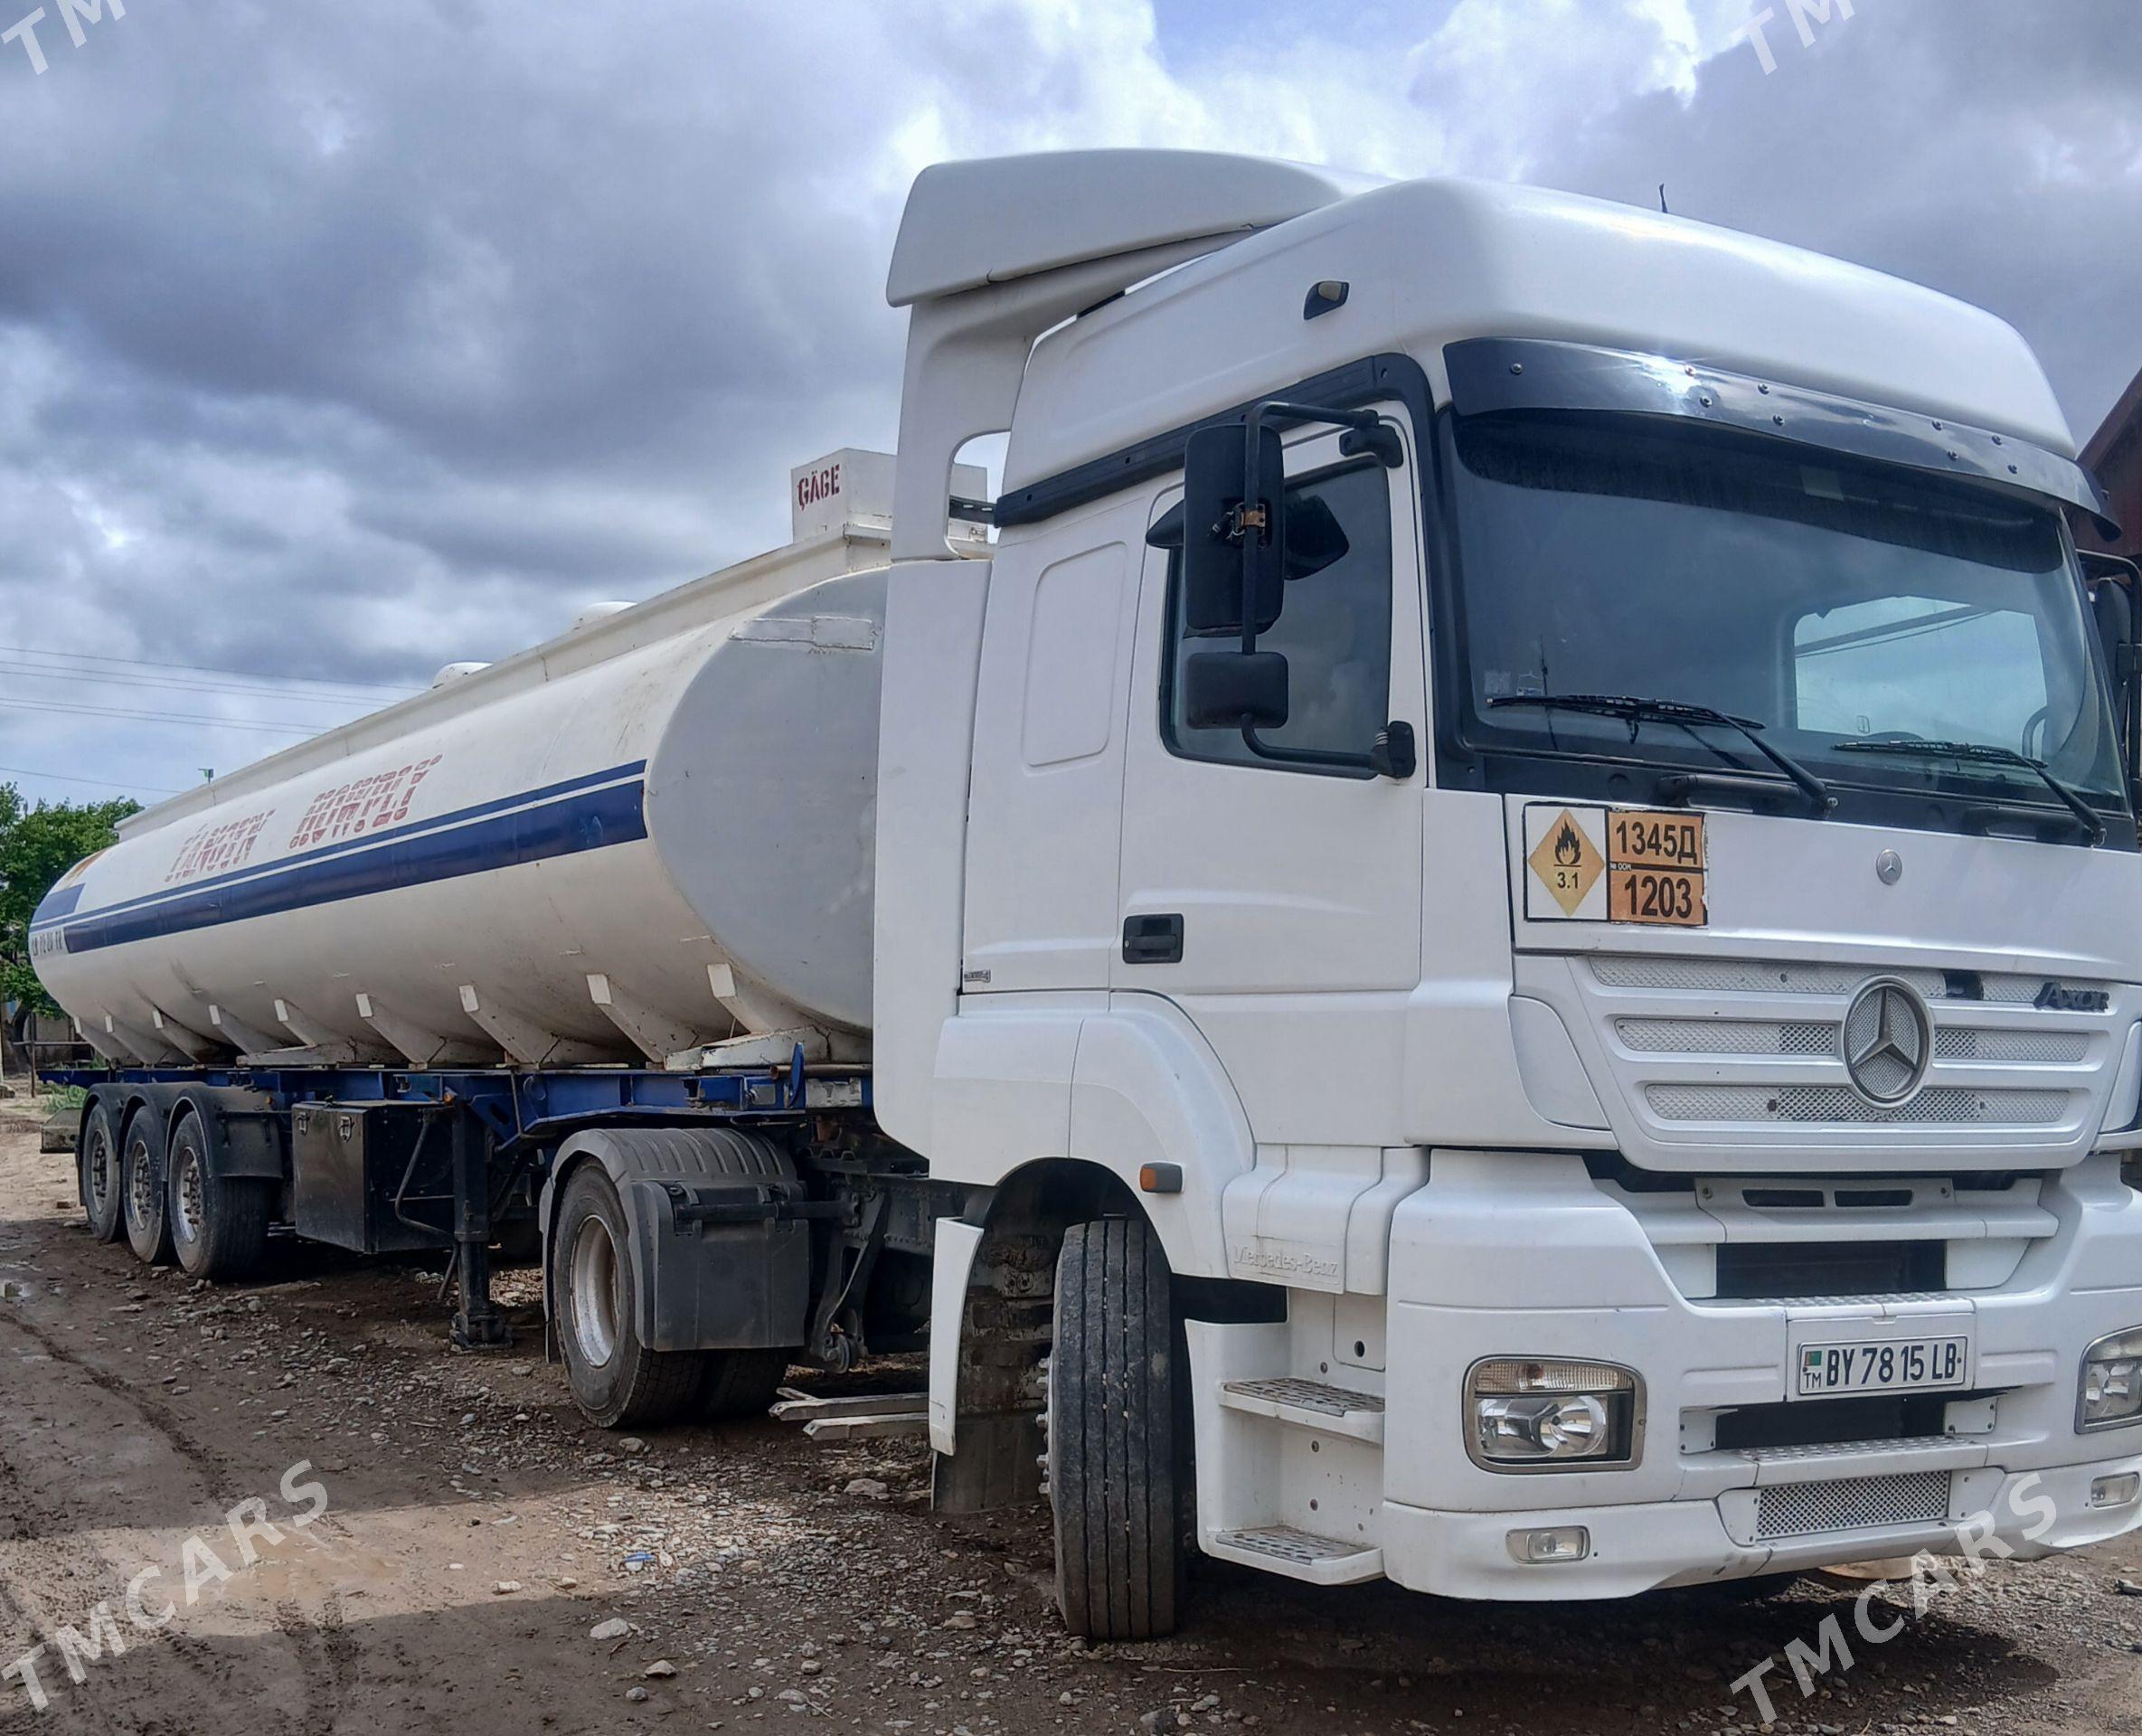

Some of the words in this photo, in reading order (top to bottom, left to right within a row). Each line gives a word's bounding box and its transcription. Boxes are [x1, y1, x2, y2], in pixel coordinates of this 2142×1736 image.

[1616, 821, 1697, 864] 1345Д
[1557, 872, 1579, 889] 3.1
[1624, 873, 1693, 920] 1203
[1804, 1373, 1822, 1389] TM
[1826, 1348, 1855, 1387] BY
[1931, 1343, 1958, 1380] LB
